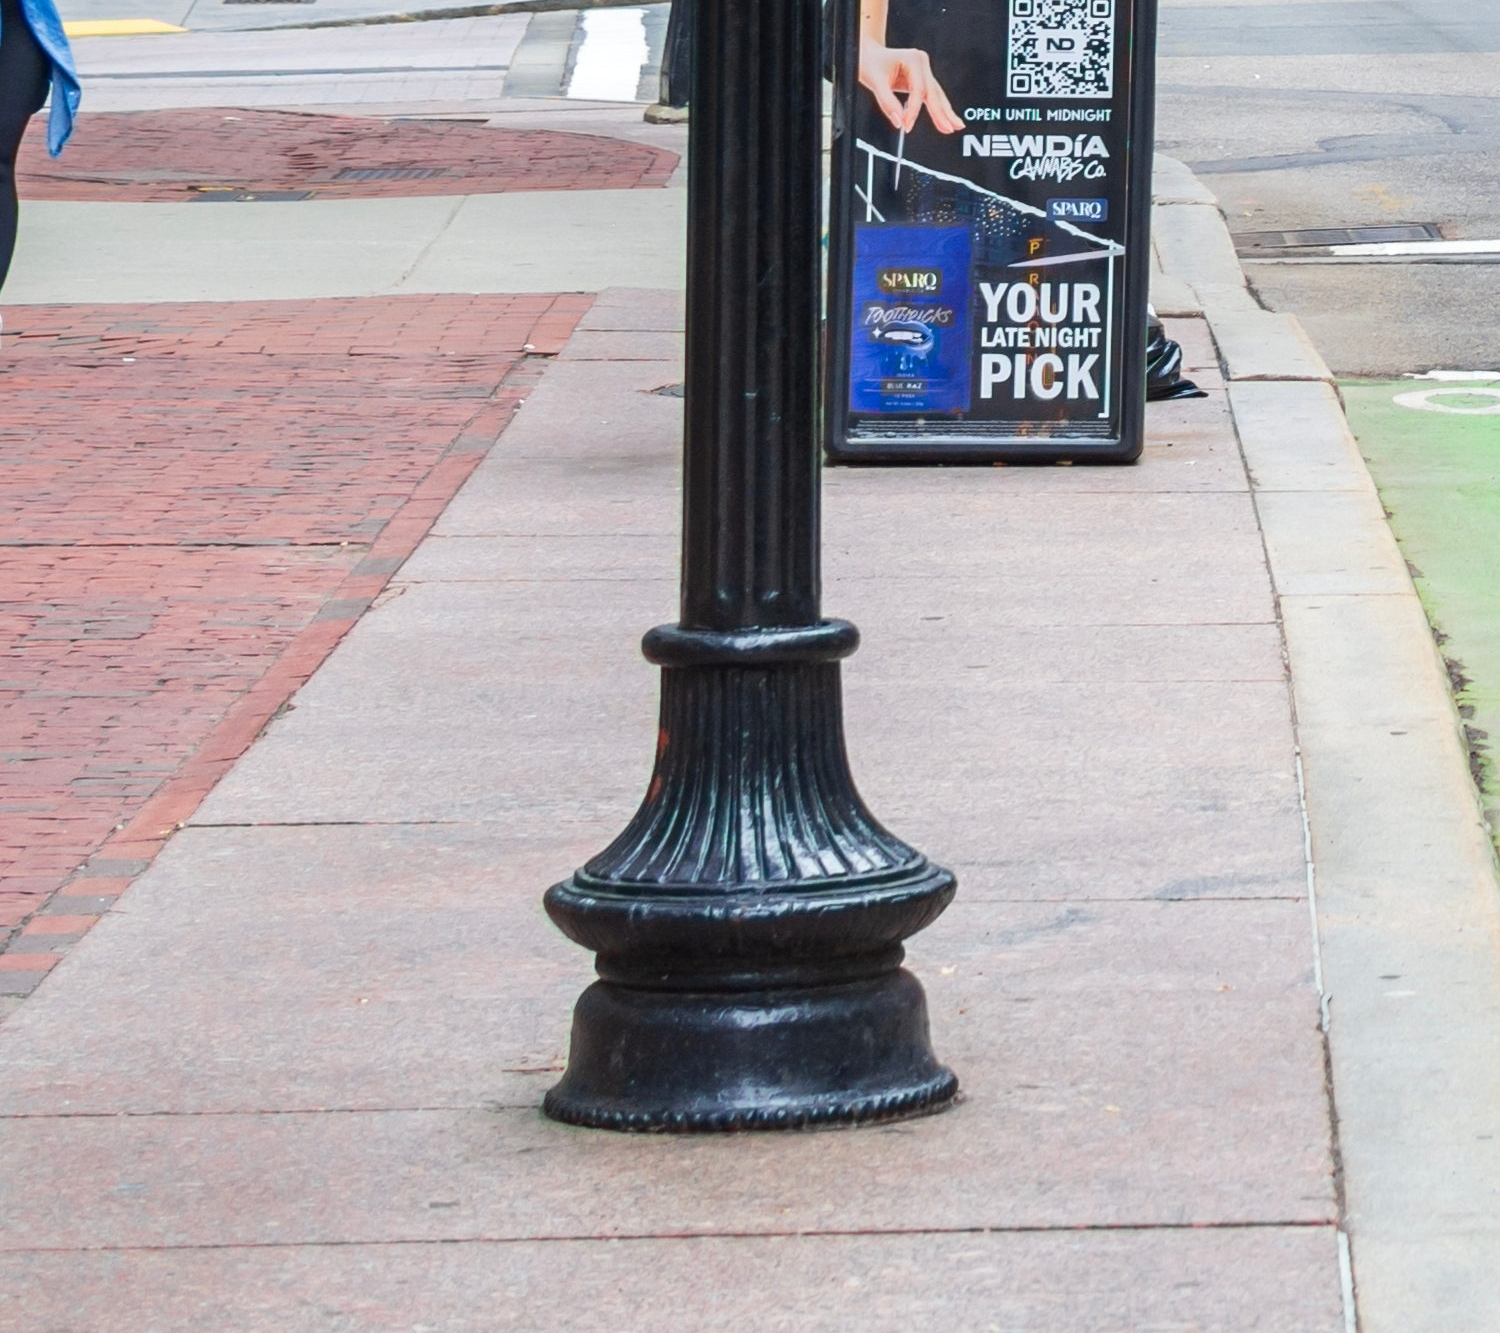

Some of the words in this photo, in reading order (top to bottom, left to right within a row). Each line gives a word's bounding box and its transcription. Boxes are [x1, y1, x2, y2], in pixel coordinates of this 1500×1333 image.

[1046, 37, 1075, 51] ND
[964, 108, 1000, 121] OPEN
[1005, 108, 1042, 121] UNTIL
[1047, 108, 1112, 121] MIDNIGHT
[1010, 154, 1083, 182] CANNABIS
[1052, 202, 1101, 218] SPARQ
[883, 273, 937, 290] SPARQ
[980, 282, 1101, 323] YOUR
[865, 306, 953, 325] TOOTHPICKS
[981, 327, 1031, 347] LATE
[1035, 327, 1102, 348] NIGHT
[980, 353, 1100, 399] PICK
